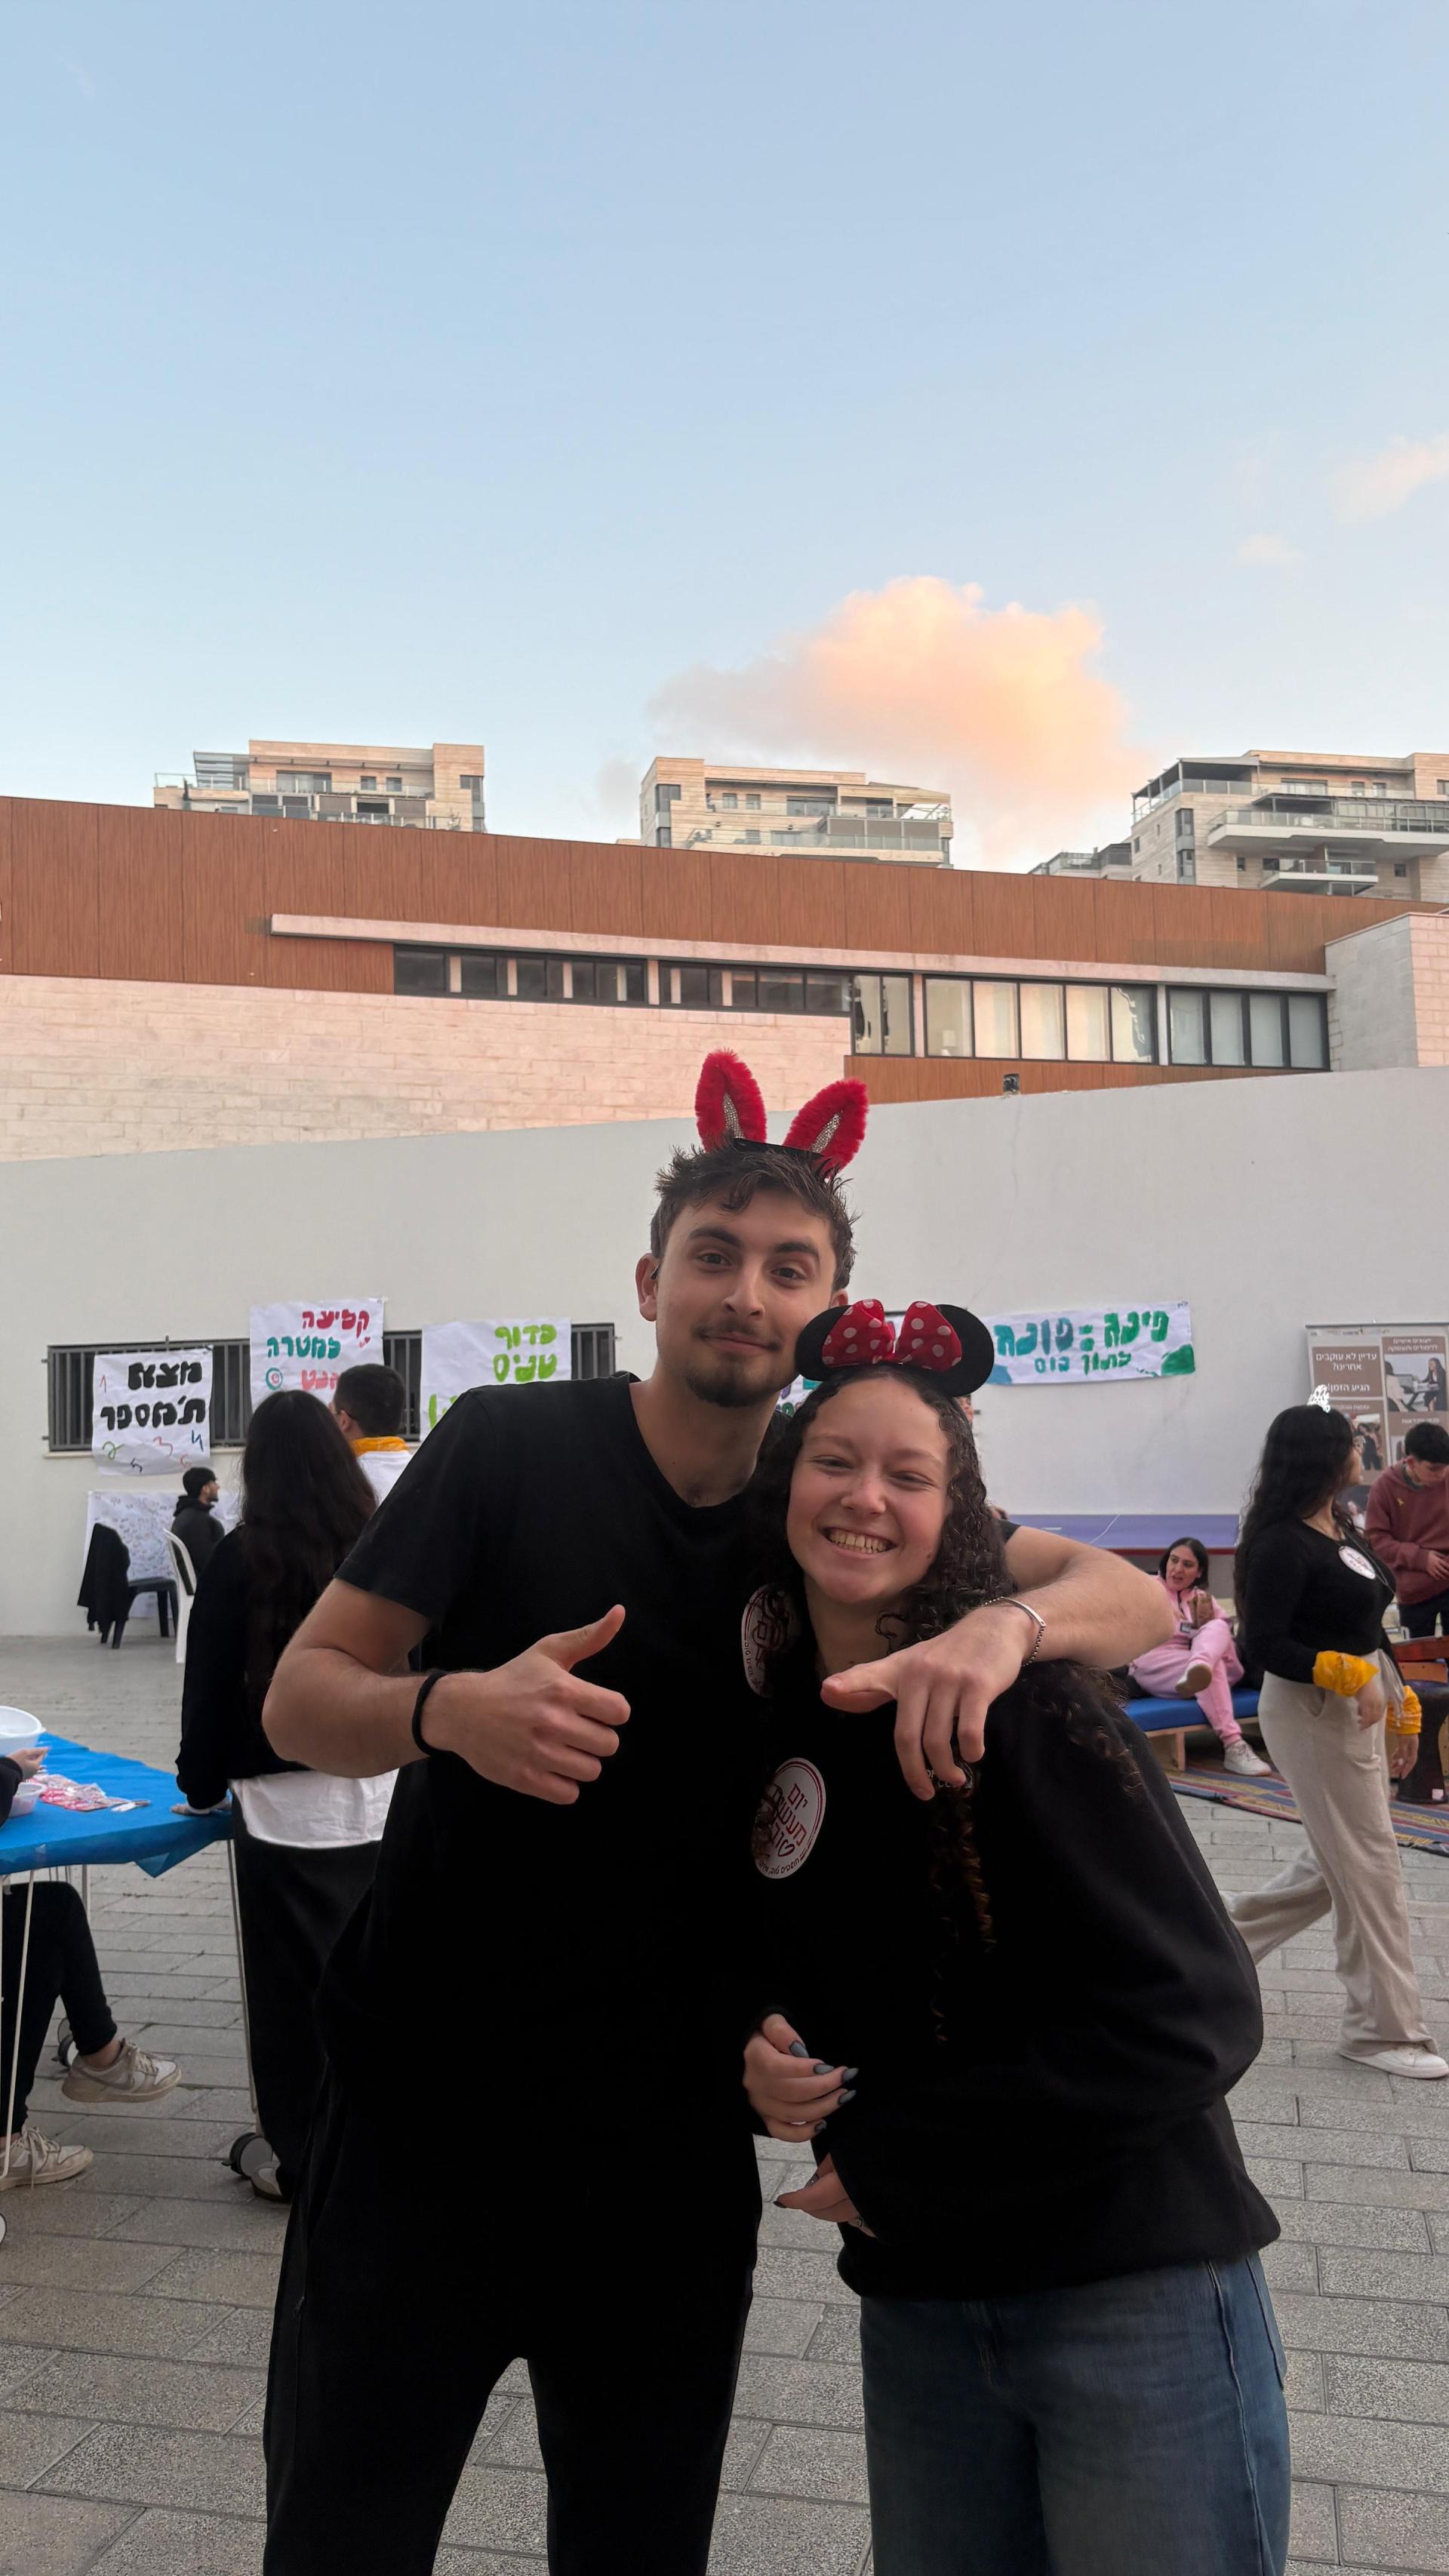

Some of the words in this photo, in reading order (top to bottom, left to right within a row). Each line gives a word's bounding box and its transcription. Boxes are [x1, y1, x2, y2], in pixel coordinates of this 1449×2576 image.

[302, 1309, 370, 1338] קליעה
[266, 1335, 341, 1359] למטרה
[1035, 1356, 1070, 1374] כוס
[1081, 1350, 1132, 1376] לתוך
[1316, 1353, 1343, 1362] עוקבים
[1333, 1362, 1362, 1371] אחרינו?
[1358, 1353, 1377, 1362] עדיין
[493, 1353, 558, 1383] טניס
[100, 1374, 106, 1393] 1
[1352, 1383, 1370, 1392] הגיע
[102, 1441, 125, 1460] 2
[153, 1436, 173, 1457] 3
[787, 1783, 808, 1810] יום
